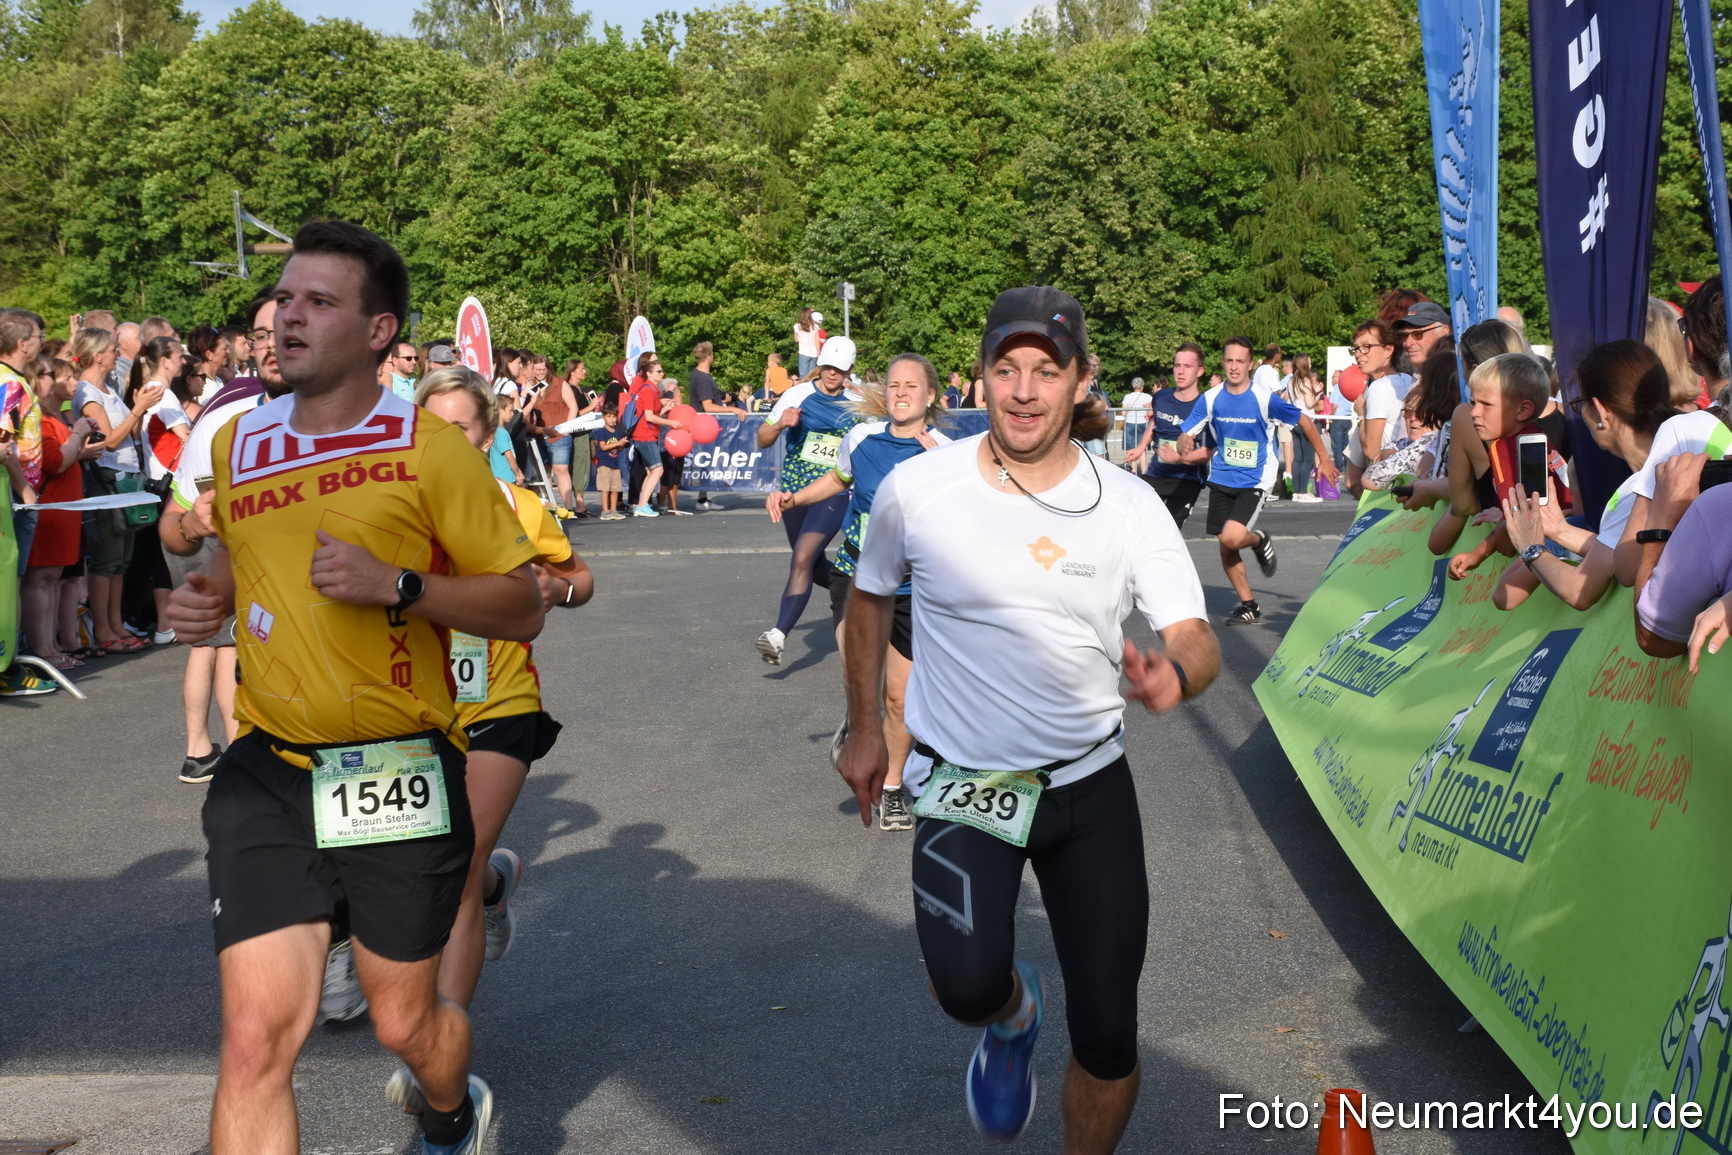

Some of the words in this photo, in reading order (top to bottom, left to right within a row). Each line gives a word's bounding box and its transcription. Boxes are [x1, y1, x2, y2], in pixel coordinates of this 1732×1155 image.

[1566, 0, 1610, 254] #GE
[683, 446, 763, 468] scher
[811, 443, 836, 458] 244
[1226, 447, 1252, 460] 2159
[682, 470, 753, 480] TOMOBILE
[229, 480, 306, 524] MAX
[317, 461, 418, 497] BÖGL
[1061, 561, 1097, 572] LANDKREIS
[1061, 568, 1096, 579] NEUMARKT
[449, 657, 475, 683] 0
[1324, 631, 1429, 697] firmenlauf
[1588, 645, 1660, 706] Gesunde
[1512, 669, 1548, 694] Fischer
[1307, 685, 1342, 708] neumarkt
[415, 763, 436, 774] 2019
[1586, 719, 1641, 795] laufen
[1633, 731, 1693, 831] länger!
[332, 775, 430, 817] 1549
[936, 781, 1019, 822] 1339
[1010, 784, 1034, 796] 2019
[1425, 743, 1564, 860] firmenlauf
[351, 817, 382, 827] Braun
[385, 813, 418, 824] Stefan
[353, 828, 370, 836] Bögl
[371, 824, 409, 834] Bauservice
[411, 820, 432, 829] GmbH
[969, 809, 995, 824] Ulrich
[1410, 832, 1462, 871] neumarkt
